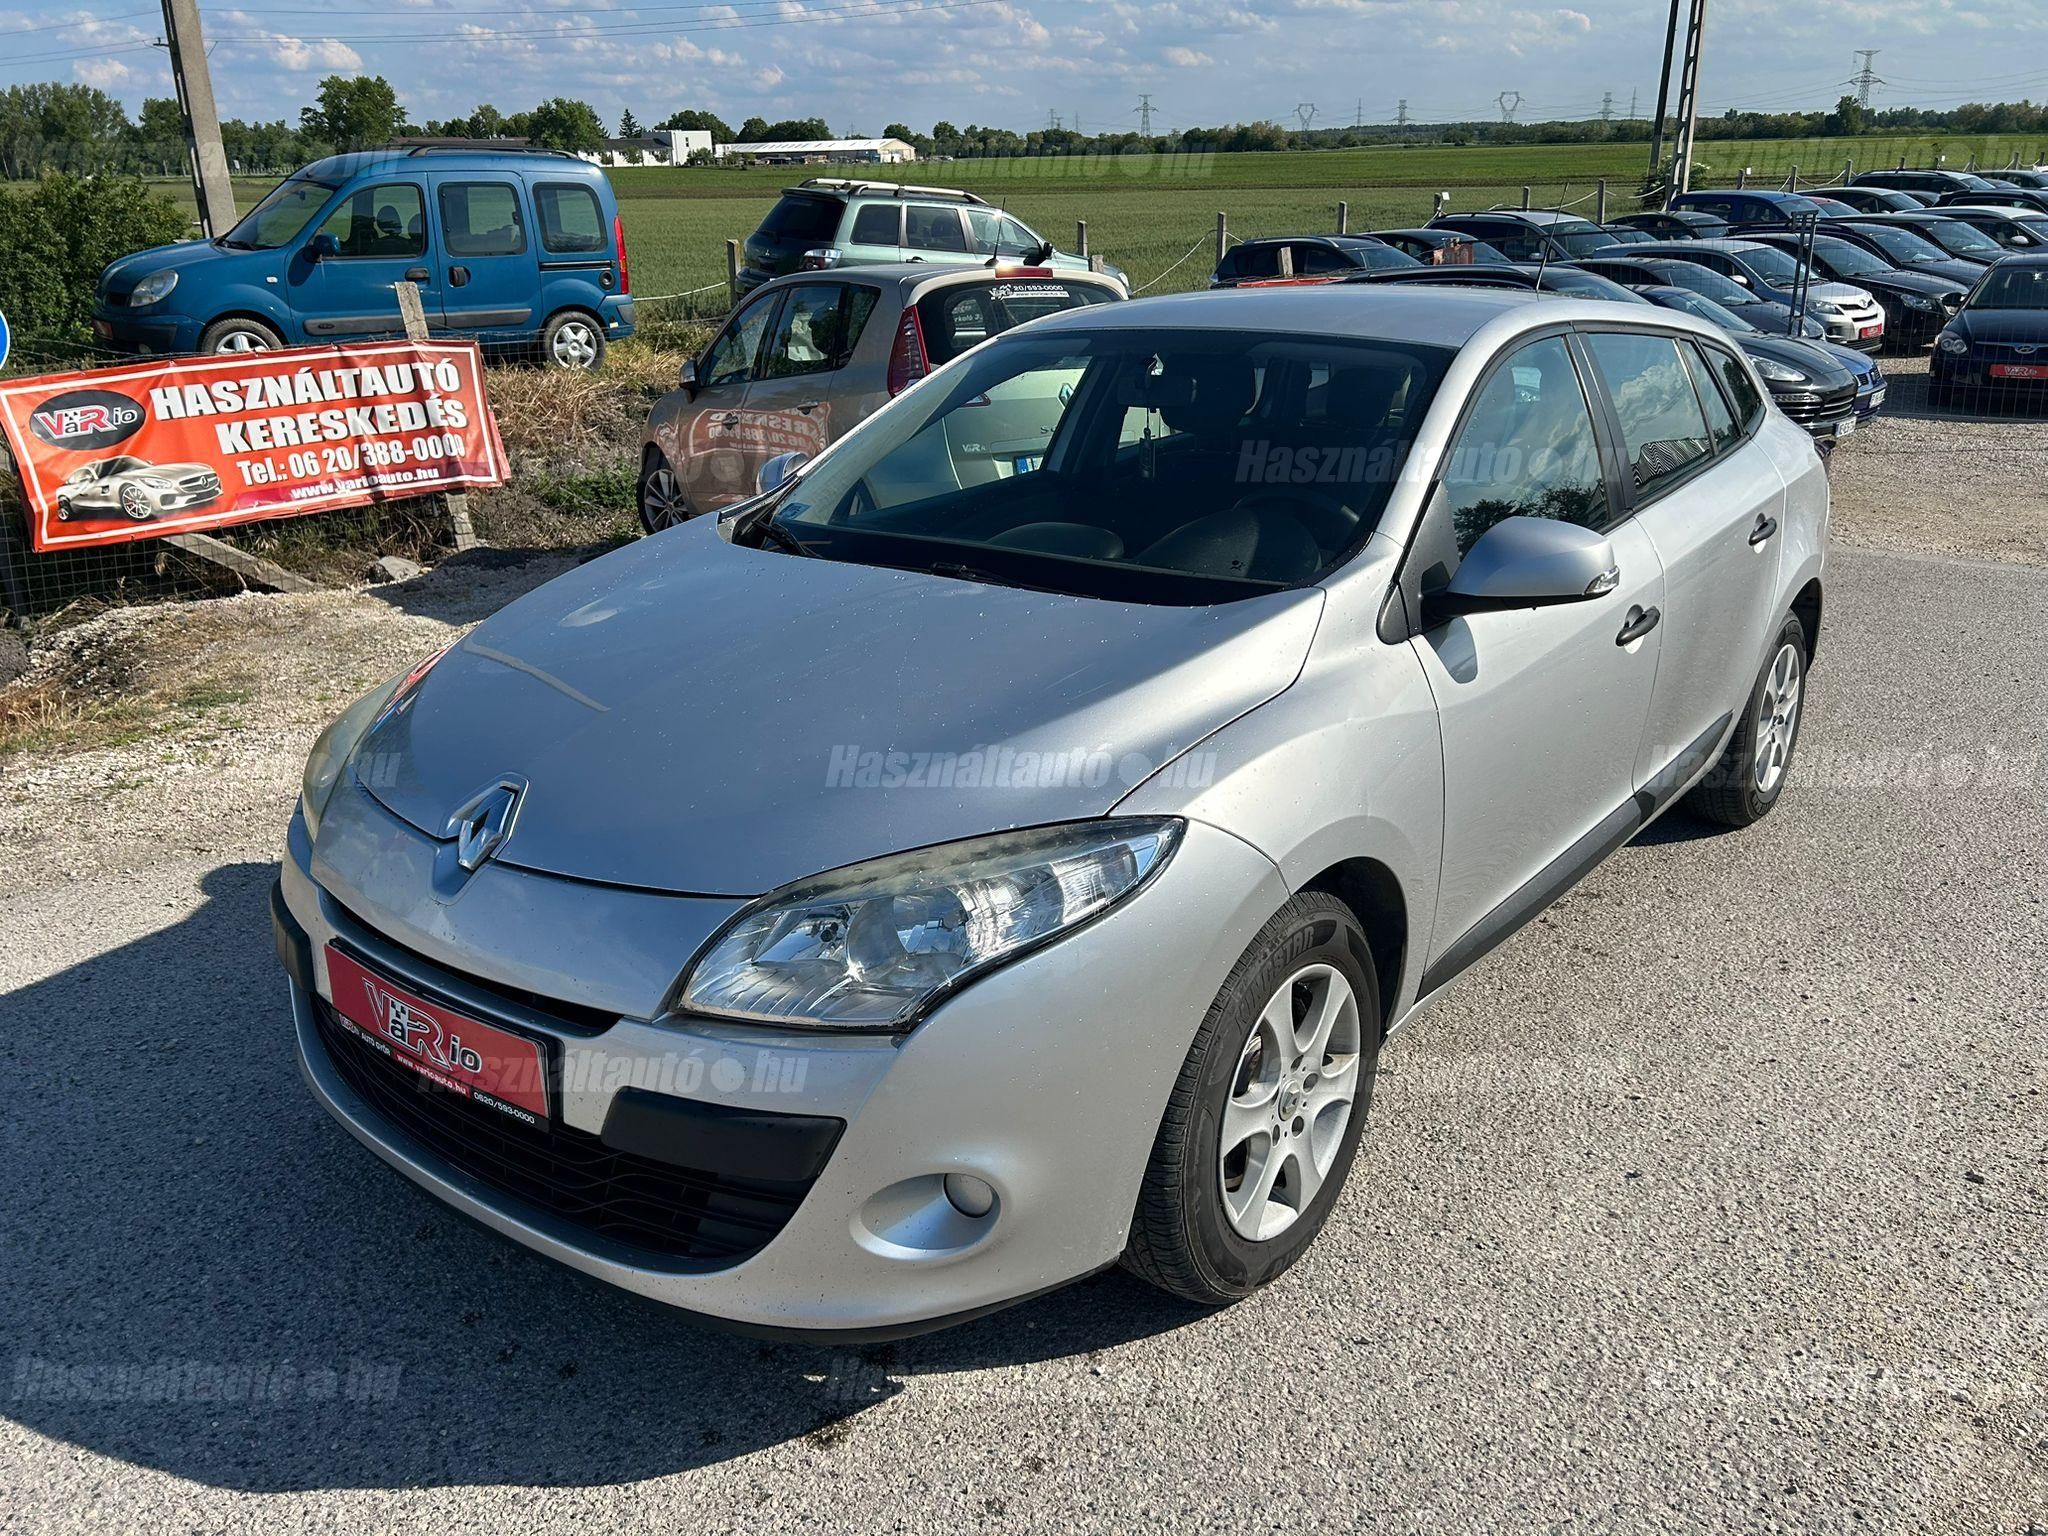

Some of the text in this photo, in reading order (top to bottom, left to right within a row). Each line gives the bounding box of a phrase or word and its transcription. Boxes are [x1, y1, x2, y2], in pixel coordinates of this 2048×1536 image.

[150, 358, 460, 421] HASZNÁLTAUTÓ
[214, 391, 468, 455] KERESKEDÉS
[237, 459, 288, 487] Tel.:
[288, 453, 321, 478] 06
[291, 467, 439, 499] www.varioauto.hu
